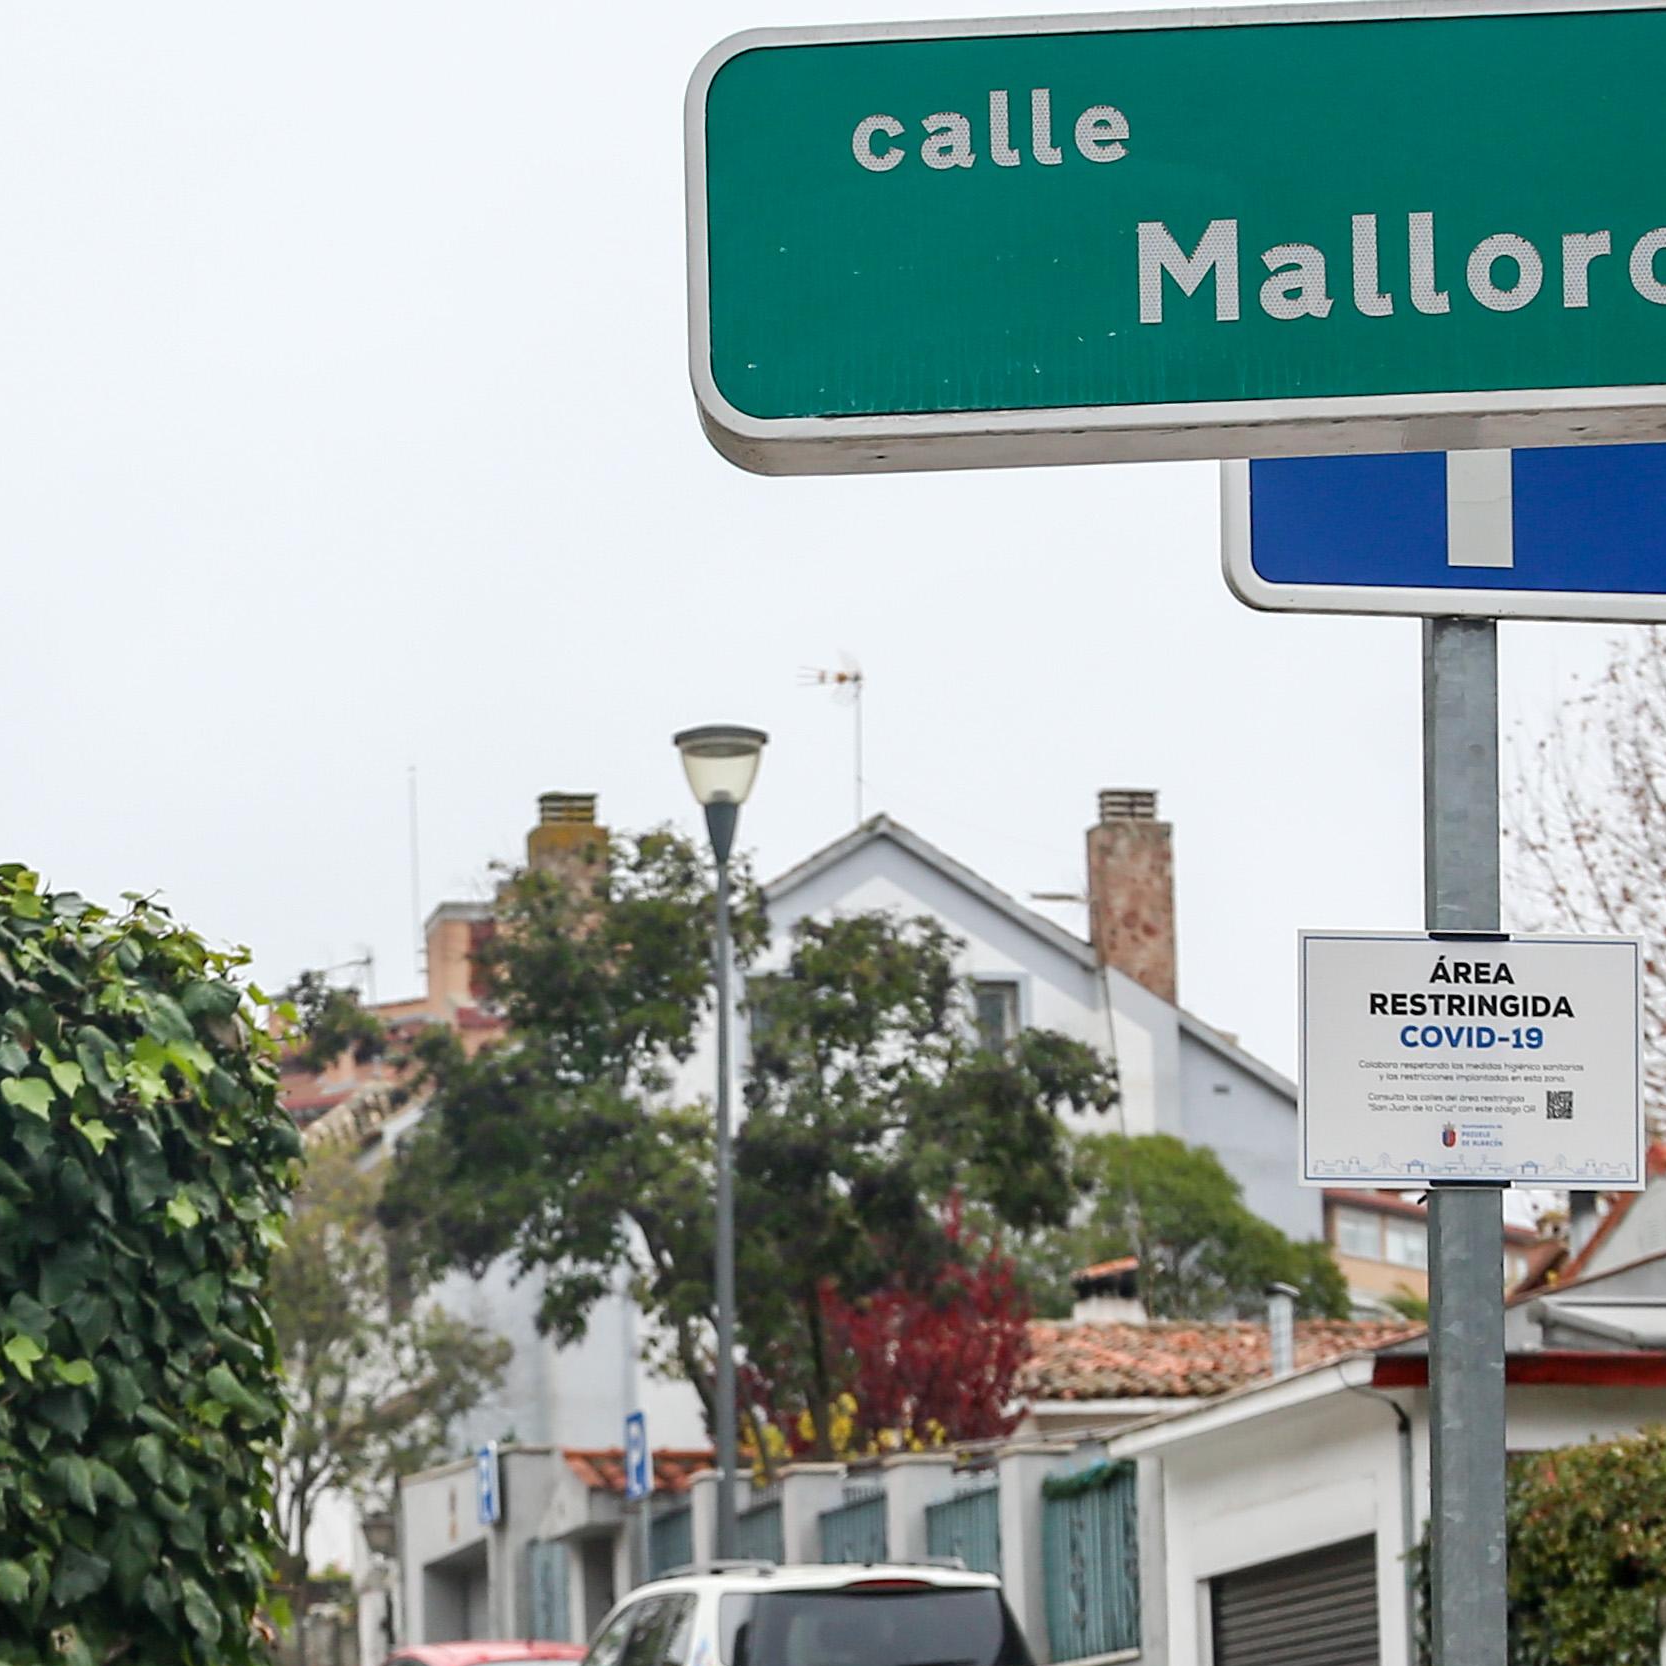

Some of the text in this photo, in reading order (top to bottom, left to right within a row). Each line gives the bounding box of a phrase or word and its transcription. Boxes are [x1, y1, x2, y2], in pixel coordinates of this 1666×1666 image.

[851, 86, 1131, 173] calle
[1429, 955, 1515, 985] ÁREA
[1369, 993, 1575, 1018] RESTRINGIDA
[1400, 1025, 1544, 1049] COVID-19
